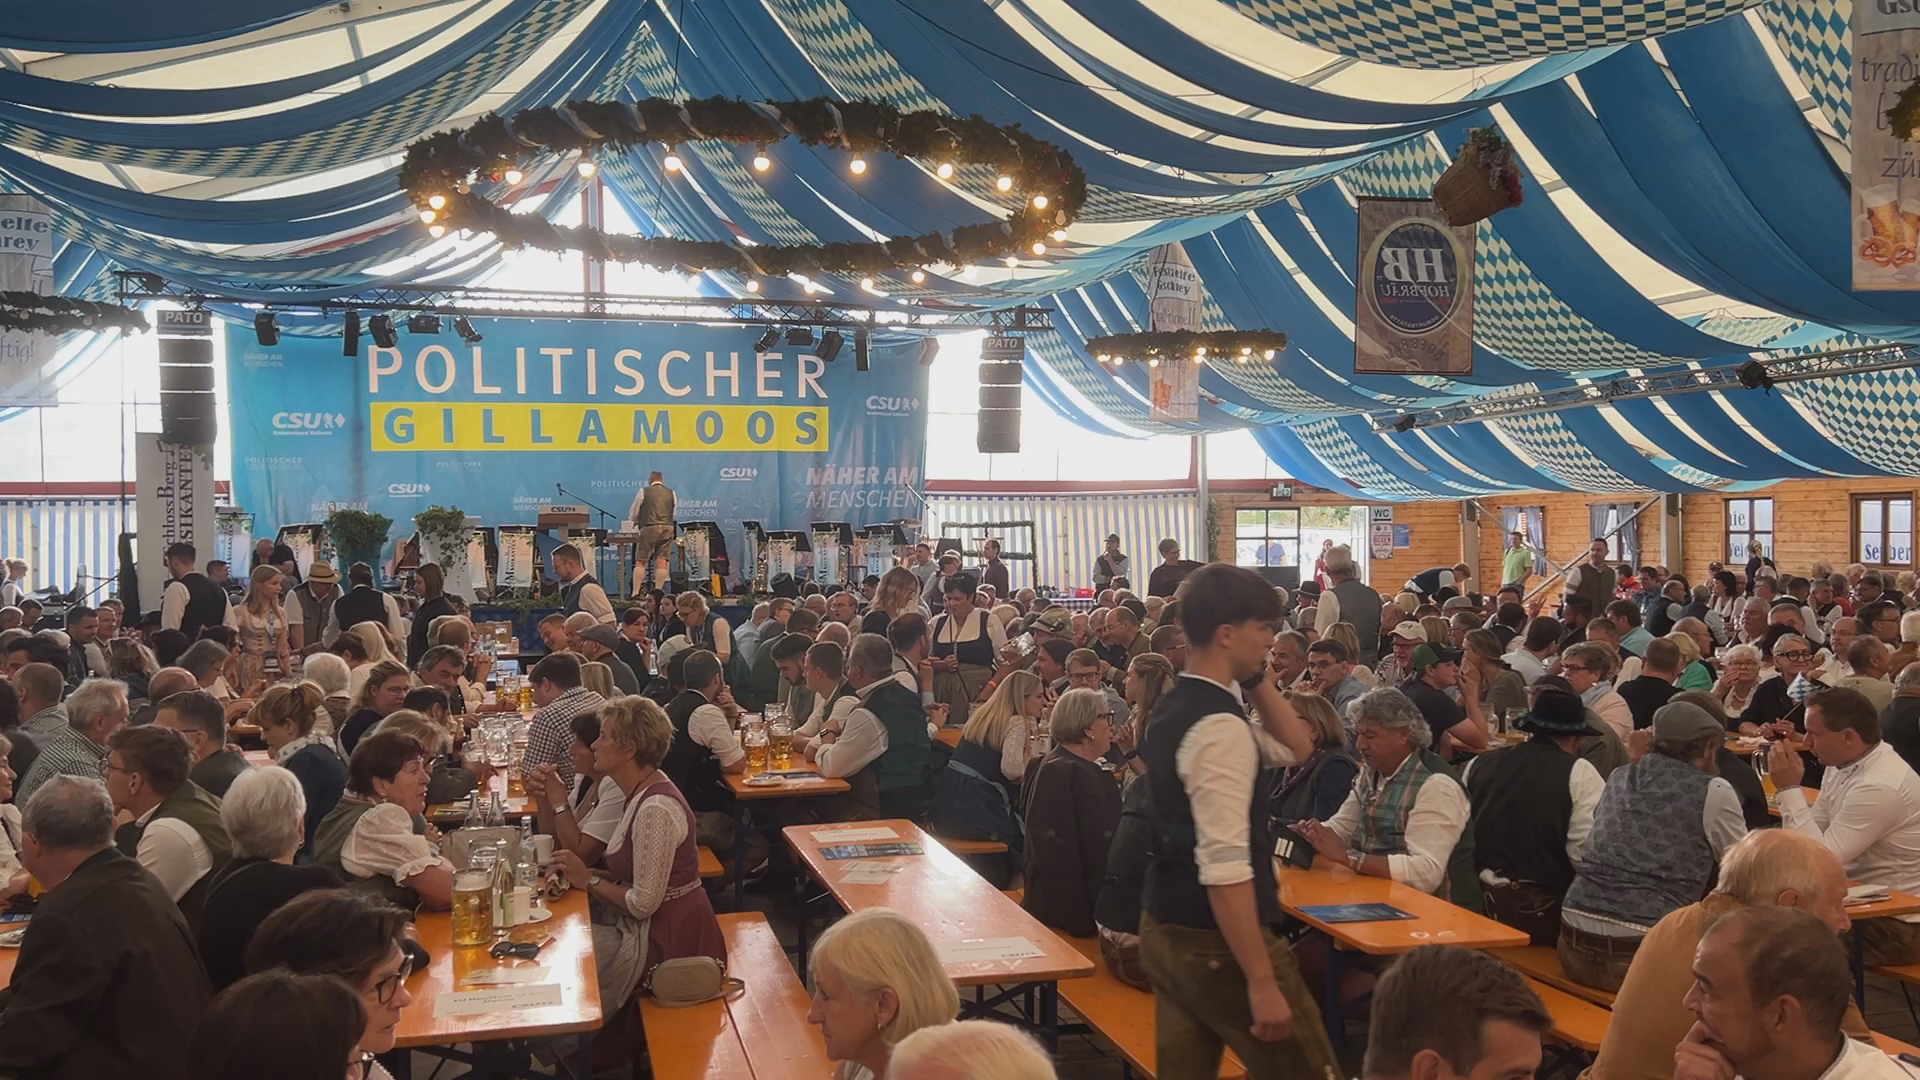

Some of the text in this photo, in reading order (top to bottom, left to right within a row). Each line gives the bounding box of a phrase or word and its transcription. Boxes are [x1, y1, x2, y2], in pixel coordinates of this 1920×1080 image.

[0, 237, 40, 251] rey
[164, 311, 204, 323] PATO
[987, 338, 1018, 348] PATO
[368, 344, 828, 399] POLITISCHER
[866, 396, 899, 410] CSU
[272, 411, 321, 429] CSU
[384, 407, 818, 445] GILLAMOOS
[245, 456, 302, 464] POLITISCHER
[720, 468, 746, 478] CSU
[806, 464, 918, 485] NÄHER AM
[388, 483, 417, 494] CSU
[676, 499, 717, 508] ÄHER AM
[806, 490, 919, 509] MENSCHEN
[157, 461, 178, 553] chlossBerg
[676, 508, 718, 517] ENSCHEN
[1374, 508, 1390, 518] WC
